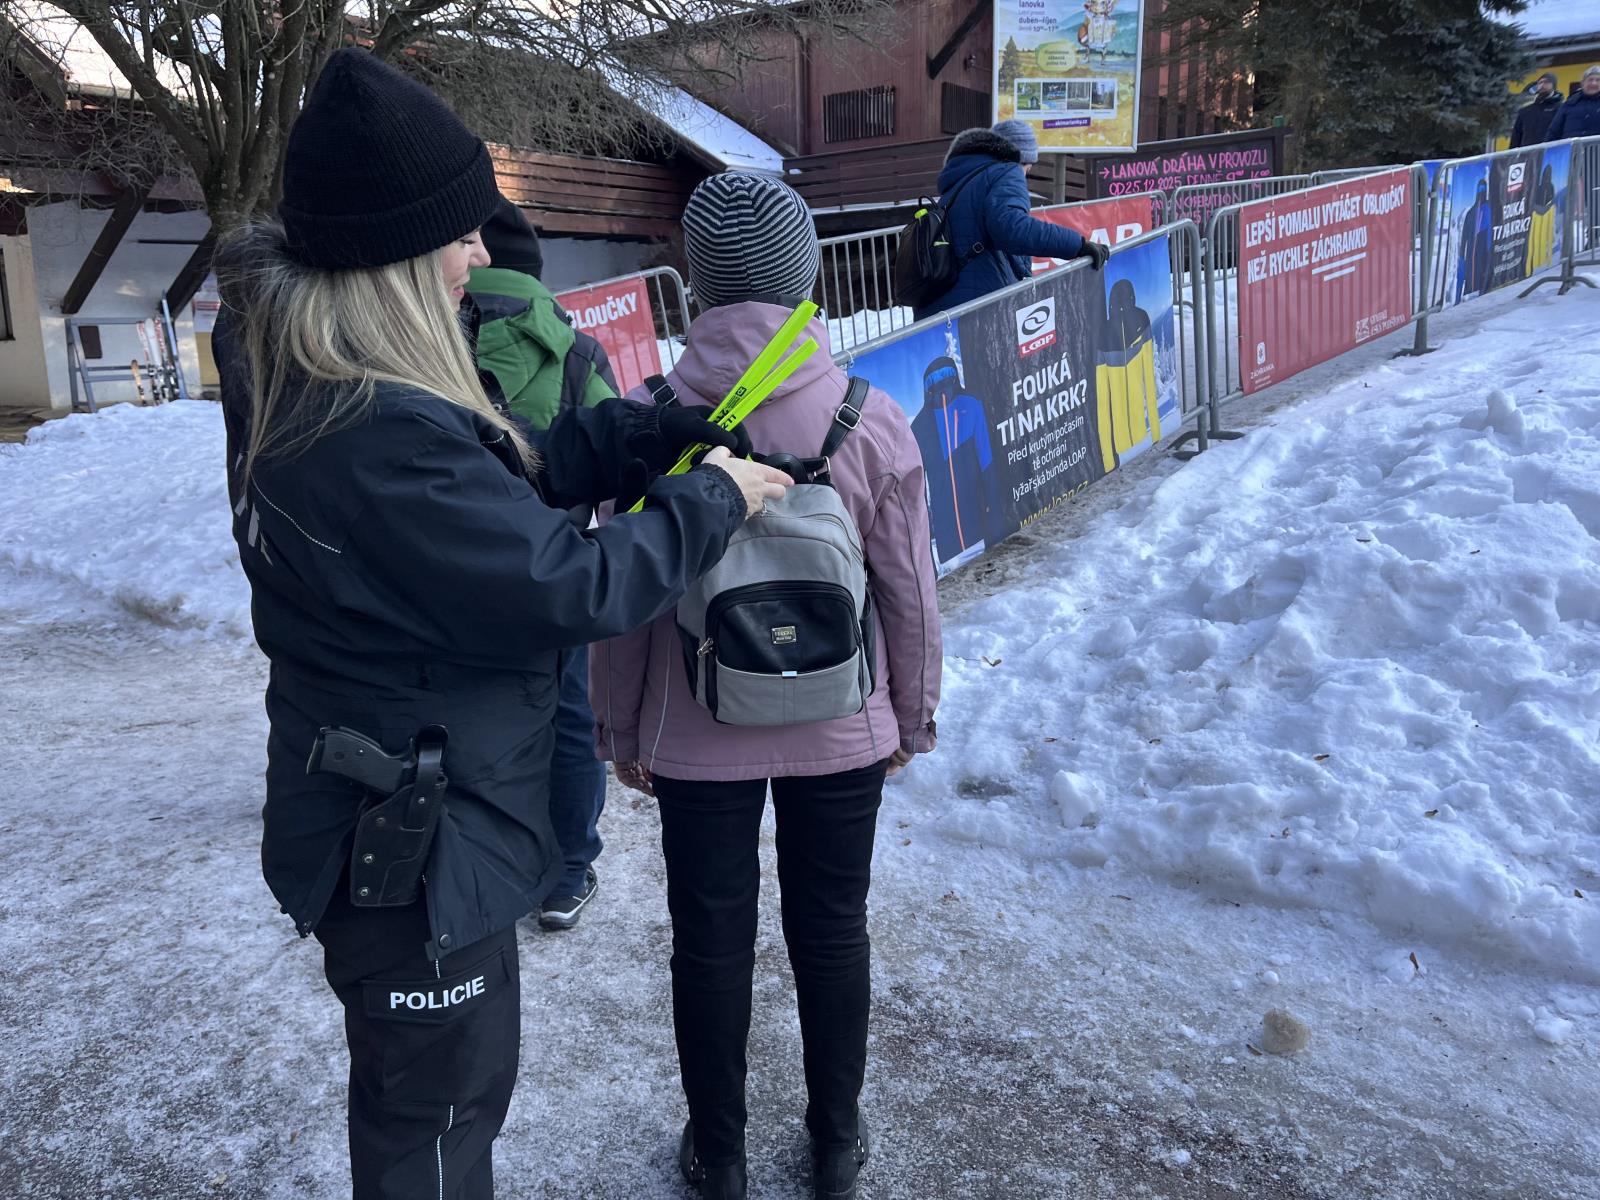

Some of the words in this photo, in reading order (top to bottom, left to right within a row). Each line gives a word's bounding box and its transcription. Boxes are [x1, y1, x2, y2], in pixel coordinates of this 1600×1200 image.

[1112, 156, 1159, 179] LANOVÁ
[1163, 151, 1206, 174] DRÁHA
[1208, 153, 1217, 169] V
[1219, 148, 1267, 169] PROVOZU
[1246, 211, 1276, 248] LEPŠÍ
[1278, 205, 1321, 239] POMALU
[1322, 193, 1361, 226] VYTÁČET
[1363, 184, 1405, 215] OBLOUČKY
[1247, 250, 1268, 284] NEŽ
[1269, 243, 1310, 277] RYCHLE
[1311, 226, 1368, 264] ZÁCHRANKU
[565, 292, 637, 330] BLOUČKY
[1021, 333, 1054, 354] LOAP
[1012, 351, 1072, 407] FOUKÁ
[997, 416, 1015, 447] TI
[1017, 404, 1045, 437] NA
[1046, 378, 1088, 422] KRK?
[1008, 444, 1028, 466] Před
[1028, 431, 1055, 455] krutým
[1055, 415, 1085, 442] počasím
[1032, 457, 1041, 470] tě
[1041, 439, 1067, 465] ochrání
[1012, 472, 1046, 502] lyžařská
[1045, 459, 1068, 481] bunda
[1068, 446, 1087, 467] LOAP
[390, 975, 486, 1010] POLICIE
